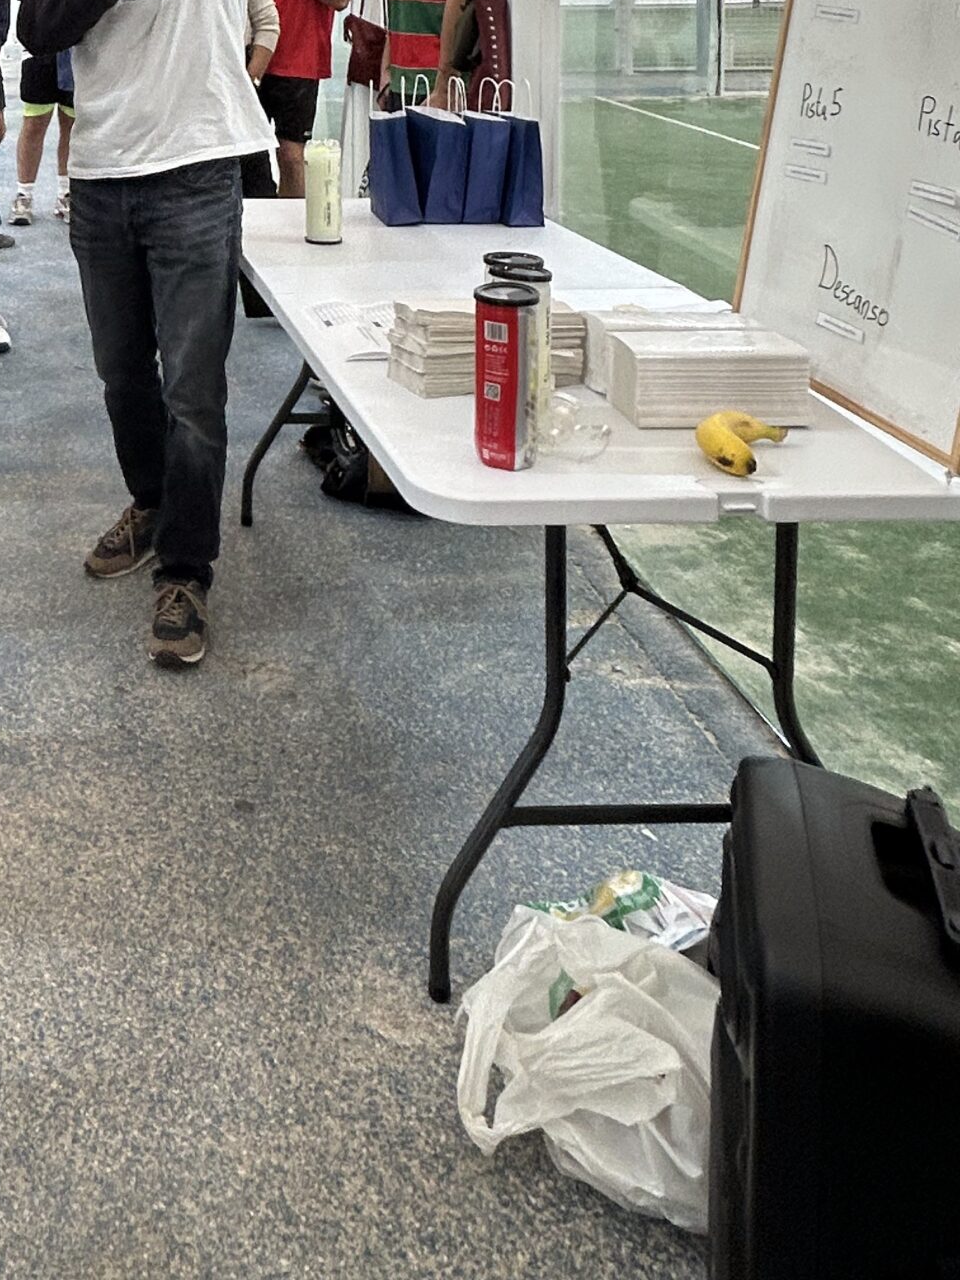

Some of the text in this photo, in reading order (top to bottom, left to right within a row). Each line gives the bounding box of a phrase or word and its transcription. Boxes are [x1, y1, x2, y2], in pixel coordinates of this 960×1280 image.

[800, 82, 843, 121] Pista 5
[817, 243, 889, 327] Descanso
